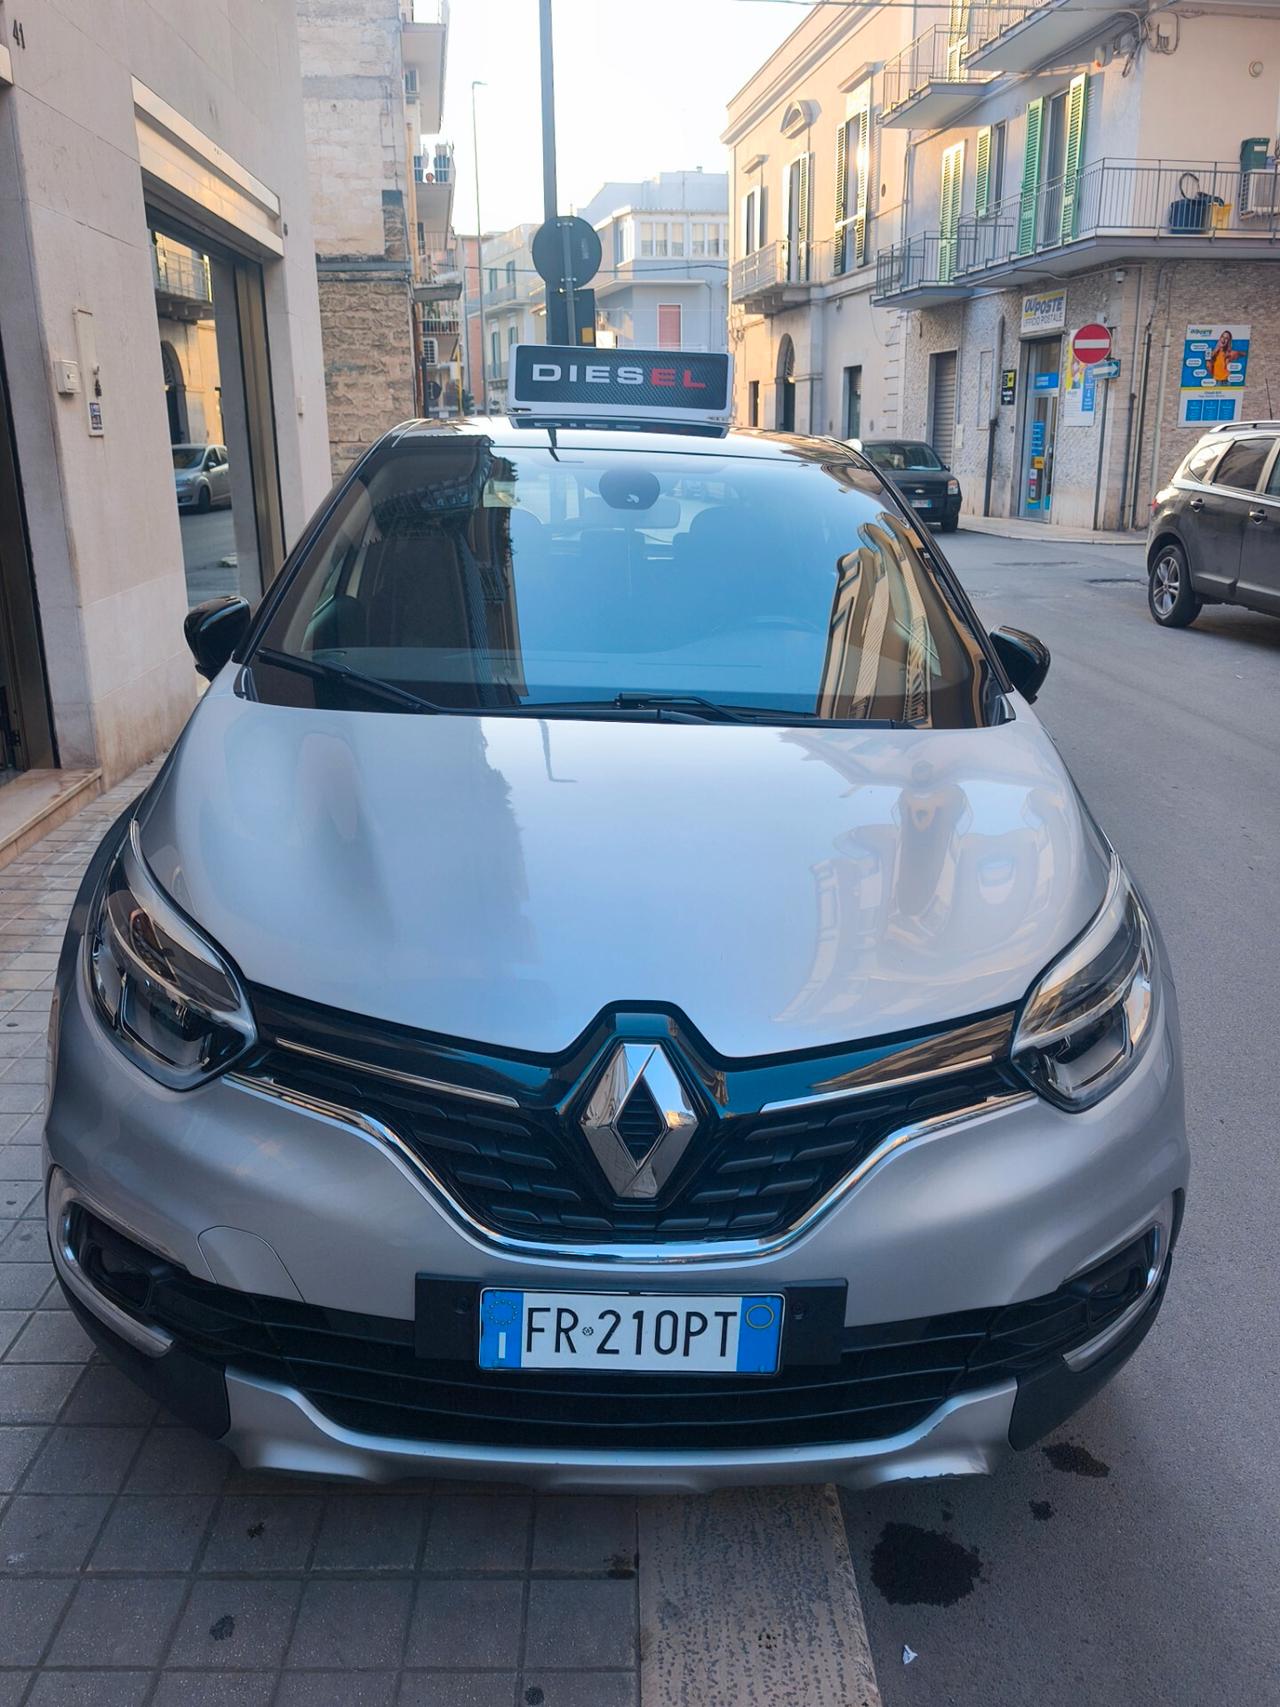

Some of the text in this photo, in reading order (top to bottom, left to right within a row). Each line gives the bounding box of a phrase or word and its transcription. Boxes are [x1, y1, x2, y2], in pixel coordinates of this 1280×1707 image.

[12, 19, 26, 50] 41
[532, 363, 706, 388] DIESEL
[526, 1307, 579, 1354] FR
